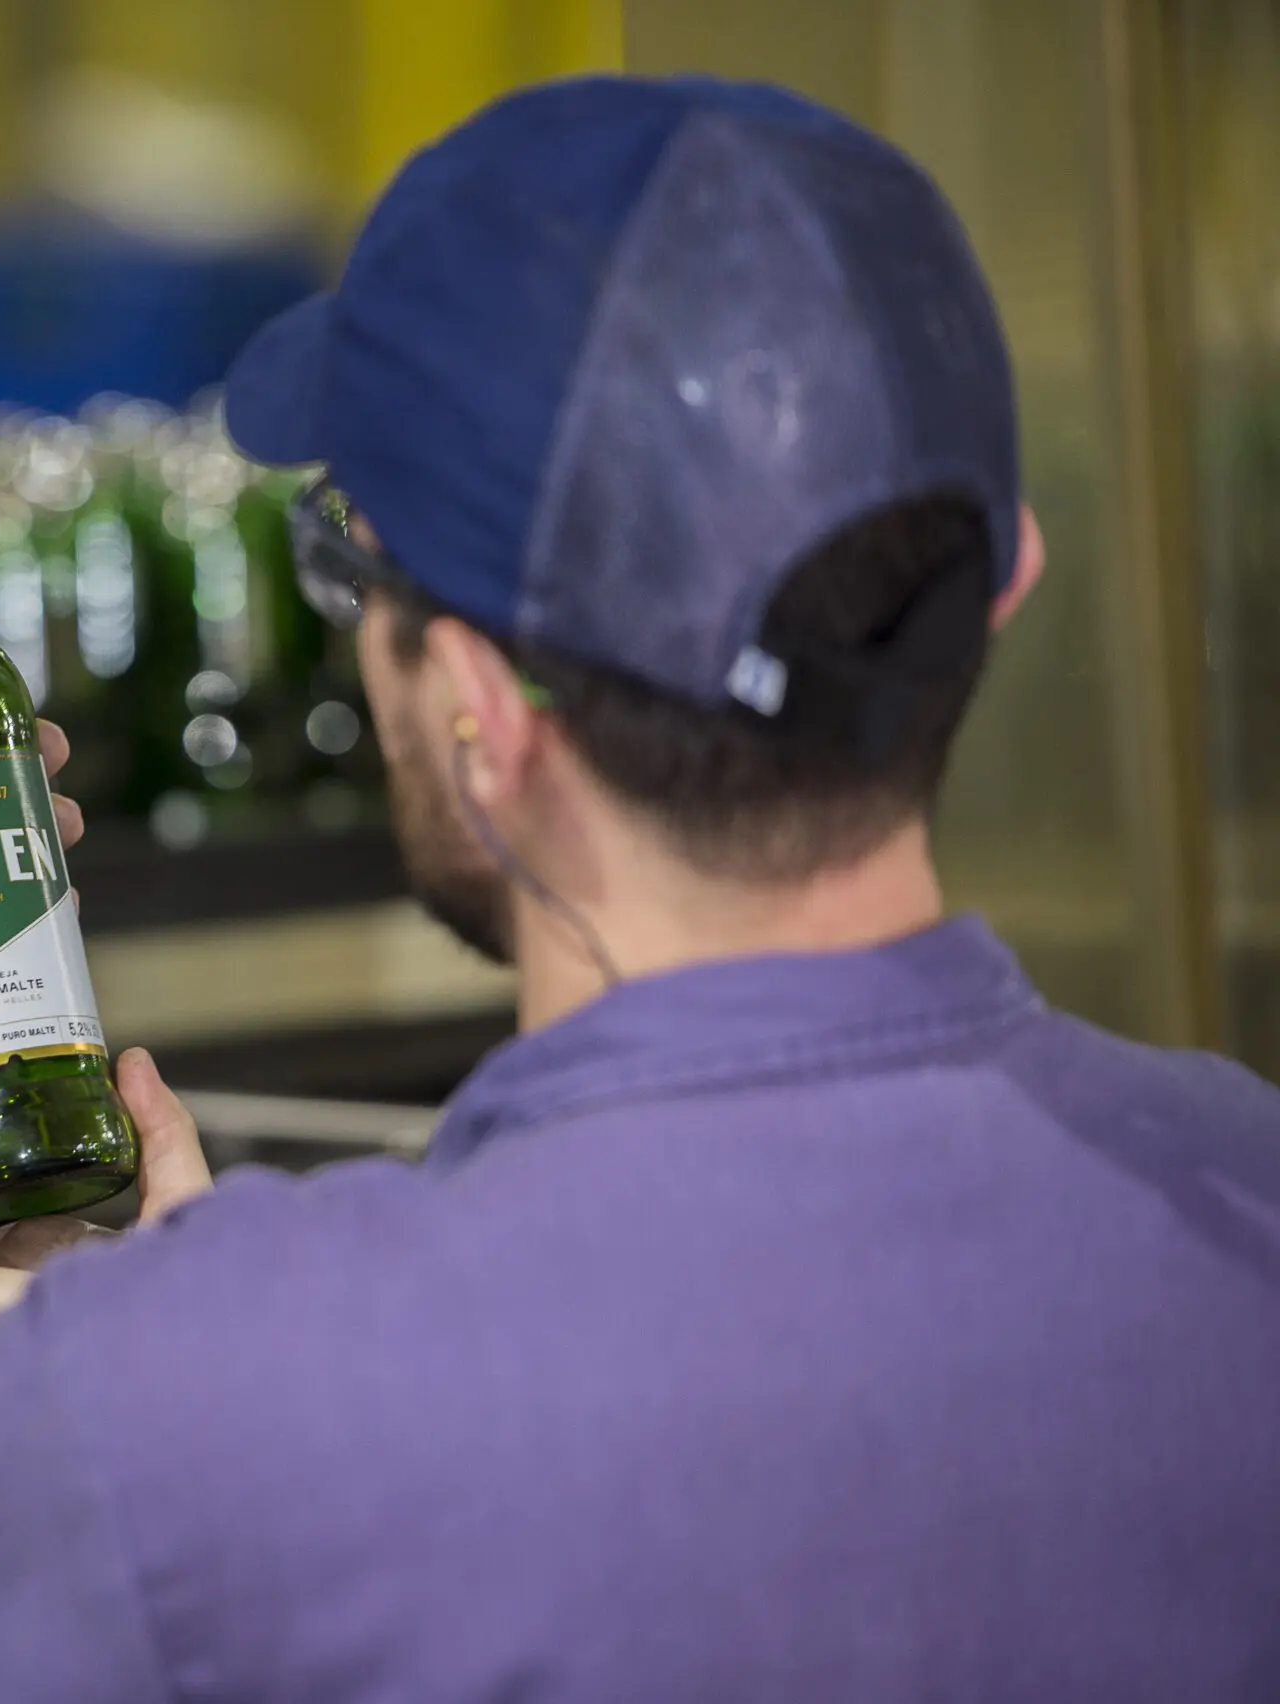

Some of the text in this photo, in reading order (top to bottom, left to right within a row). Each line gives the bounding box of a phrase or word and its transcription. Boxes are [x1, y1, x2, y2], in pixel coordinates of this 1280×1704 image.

[4, 993, 42, 1004] HELLES
[2, 1029, 26, 1040] PURO
[28, 1026, 56, 1036] MALTE
